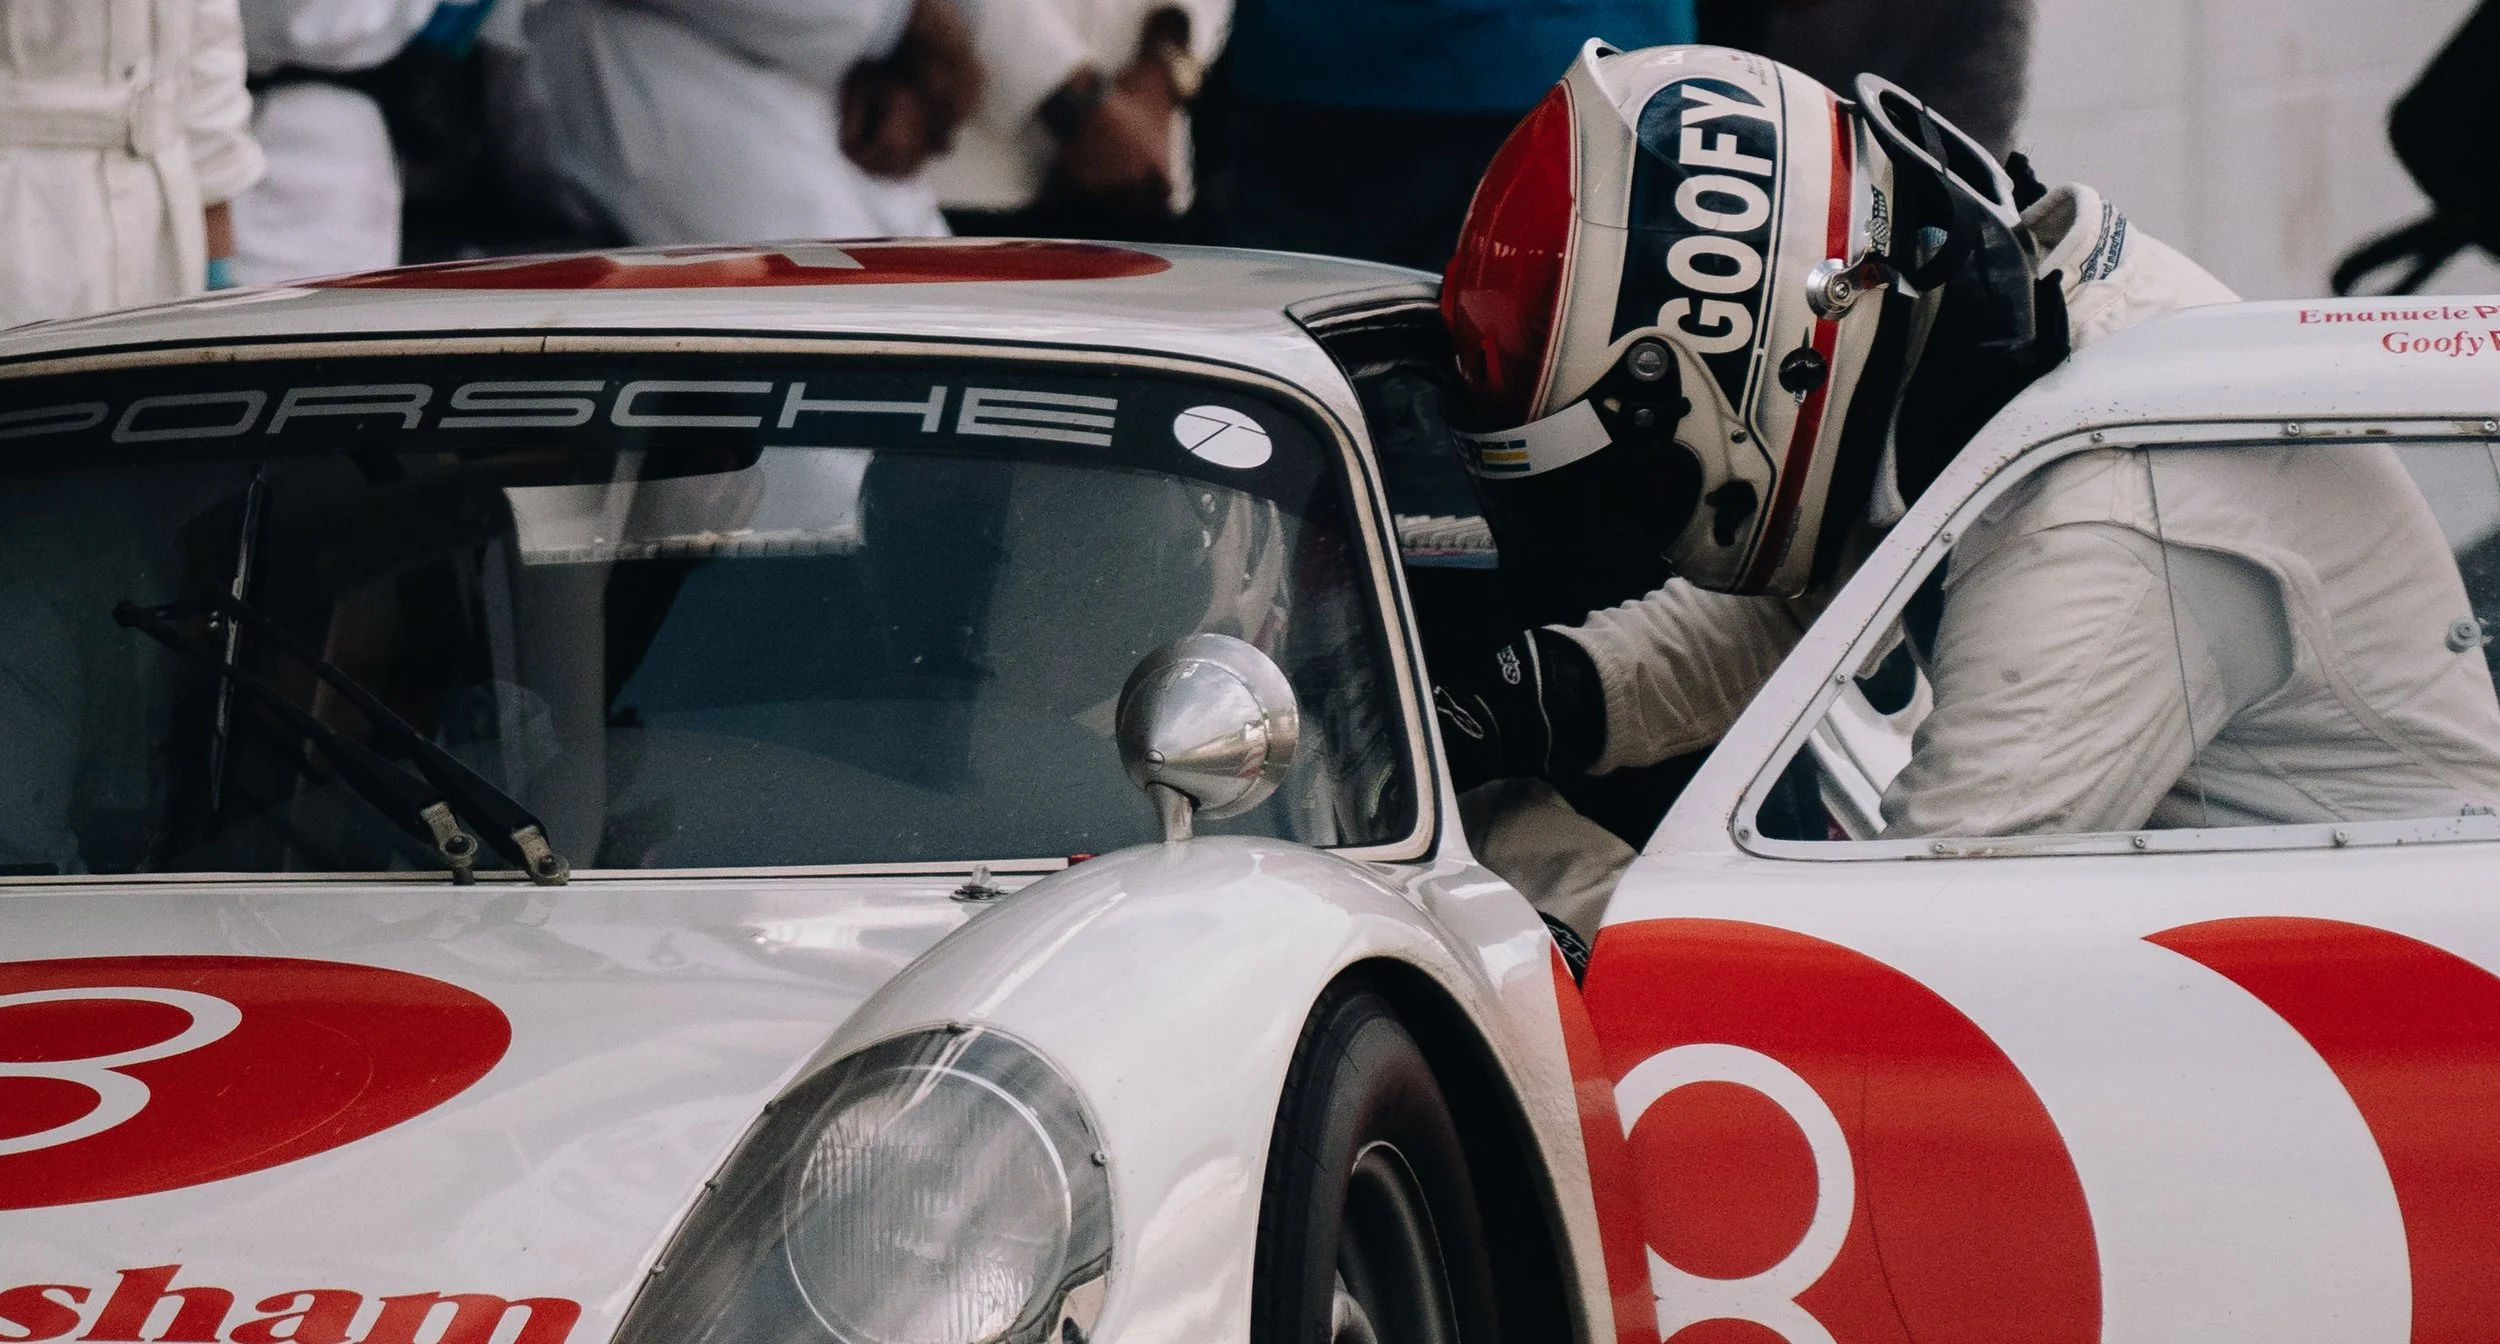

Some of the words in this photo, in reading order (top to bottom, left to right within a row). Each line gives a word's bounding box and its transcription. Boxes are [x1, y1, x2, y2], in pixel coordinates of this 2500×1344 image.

[1657, 84, 1775, 354] GOOFY
[2299, 306, 2470, 324] Emanuele
[2473, 305, 2500, 319] P
[2382, 331, 2484, 357] Goofy
